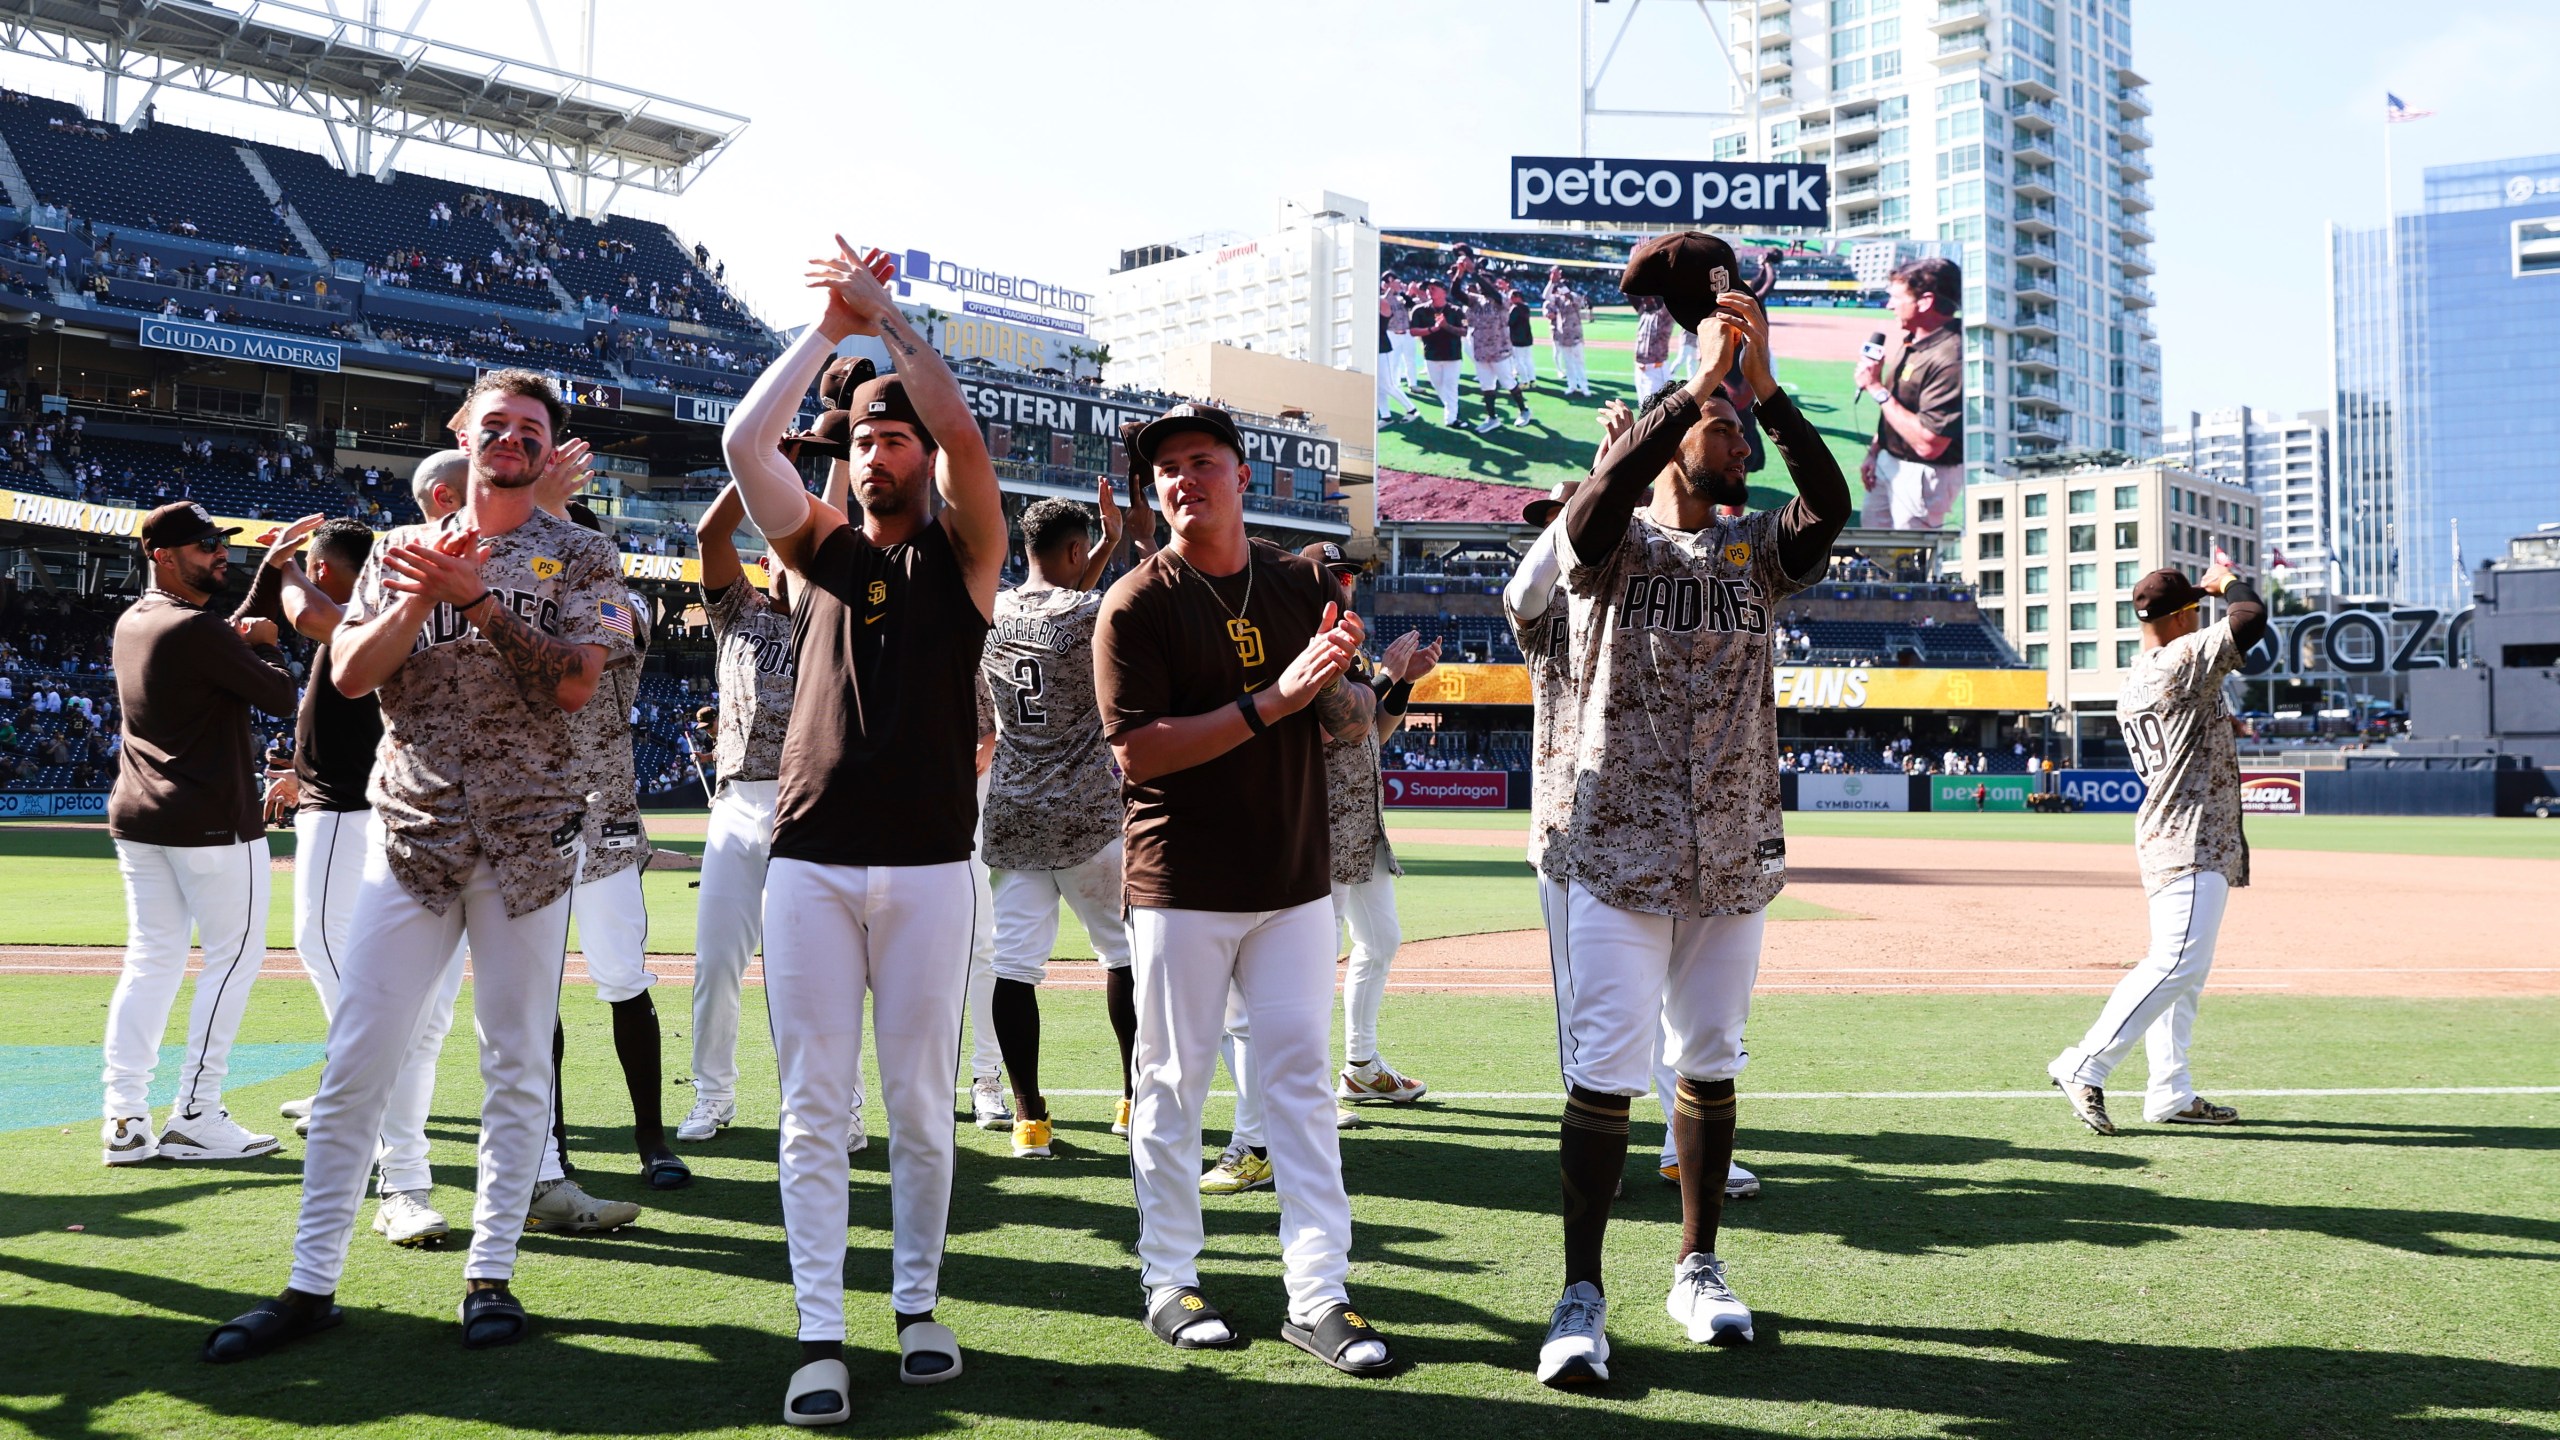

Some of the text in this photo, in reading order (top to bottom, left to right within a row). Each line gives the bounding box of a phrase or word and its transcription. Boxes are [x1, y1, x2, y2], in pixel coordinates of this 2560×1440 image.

[1517, 160, 1822, 220] petco park
[938, 260, 1087, 313] QuidelOrtho
[968, 302, 1083, 332] OFFICIAL DIAGNOSTICS PARTNER
[146, 325, 337, 367] CIUDAD MADERAS
[944, 320, 1046, 369] PADRES
[960, 384, 1077, 431] ESTERN
[1242, 431, 1287, 463] PLY
[1297, 440, 1337, 473] CO.
[13, 494, 138, 536] THANK YOU
[537, 561, 555, 574] PS
[629, 554, 684, 580] FANS
[1729, 547, 1745, 561] PS
[1617, 574, 1768, 637] PADRES
[1013, 656, 1048, 726] 2
[1775, 669, 1869, 708] FANS
[2122, 712, 2169, 780] 39
[54, 793, 104, 815] petco
[1410, 782, 1499, 800] Snapdragon
[1815, 800, 1890, 810] CYMBIOTIKA
[2064, 780, 2142, 803] ARCO
